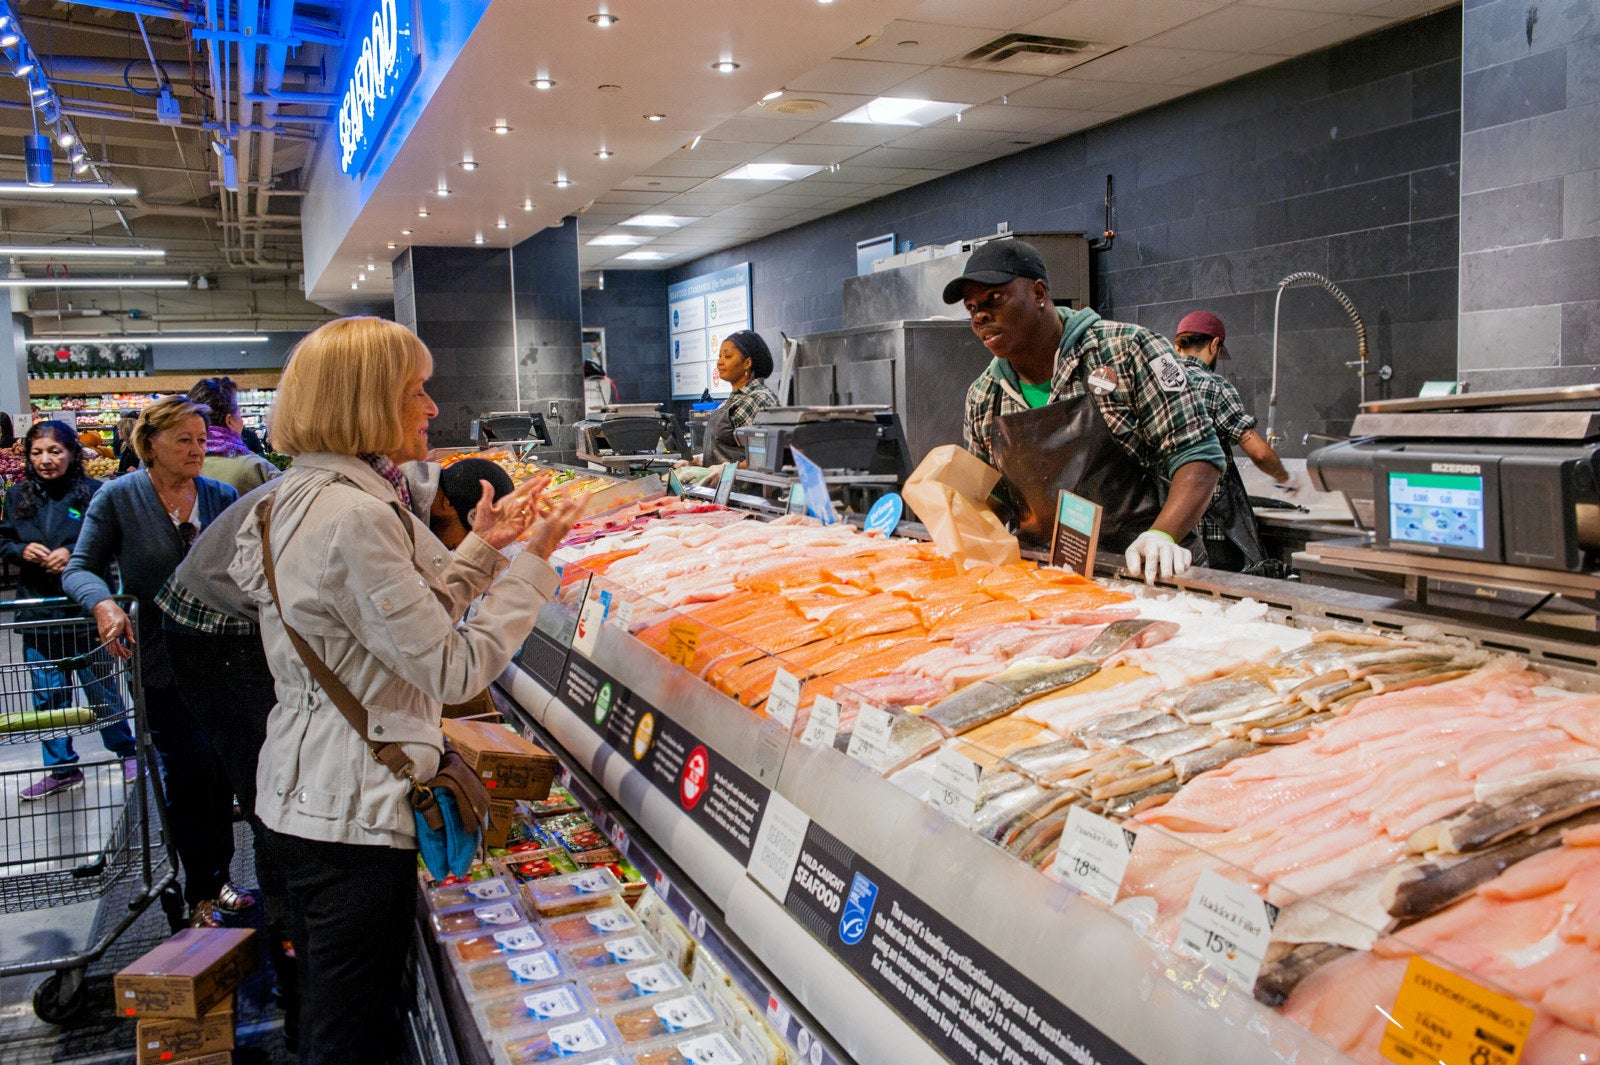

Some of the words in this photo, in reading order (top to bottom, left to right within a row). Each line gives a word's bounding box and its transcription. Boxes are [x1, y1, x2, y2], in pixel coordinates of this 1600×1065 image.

[1431, 463, 1481, 474] BIZERBA
[870, 499, 895, 520] prime
[794, 865, 841, 914] SEAFOOD
[801, 850, 846, 894] WILD-CAUGHT
[1199, 894, 1237, 923] Haddock
[874, 911, 887, 931] the
[884, 918, 907, 948] Marine
[905, 935, 946, 981] Stewardship
[944, 967, 974, 1001] Council
[970, 988, 997, 1023] (MSC)
[994, 1007, 1004, 1027] is
[1002, 1018, 1011, 1033] a
[891, 900, 903, 921] The
[901, 911, 925, 939] world's
[923, 926, 950, 960] leading
[947, 948, 994, 992] certification
[990, 983, 1028, 1019] program
[1026, 1006, 1041, 1029] for
[870, 952, 882, 971] for
[879, 960, 908, 994] fisheries
[905, 983, 916, 1001] to
[912, 993, 941, 1025] address
[939, 1012, 954, 1038] key
[952, 1023, 978, 1061] issues,
[888, 947, 899, 963] an
[896, 951, 940, 1002] international,
[939, 990, 1006, 1053] multi-stakeholder
